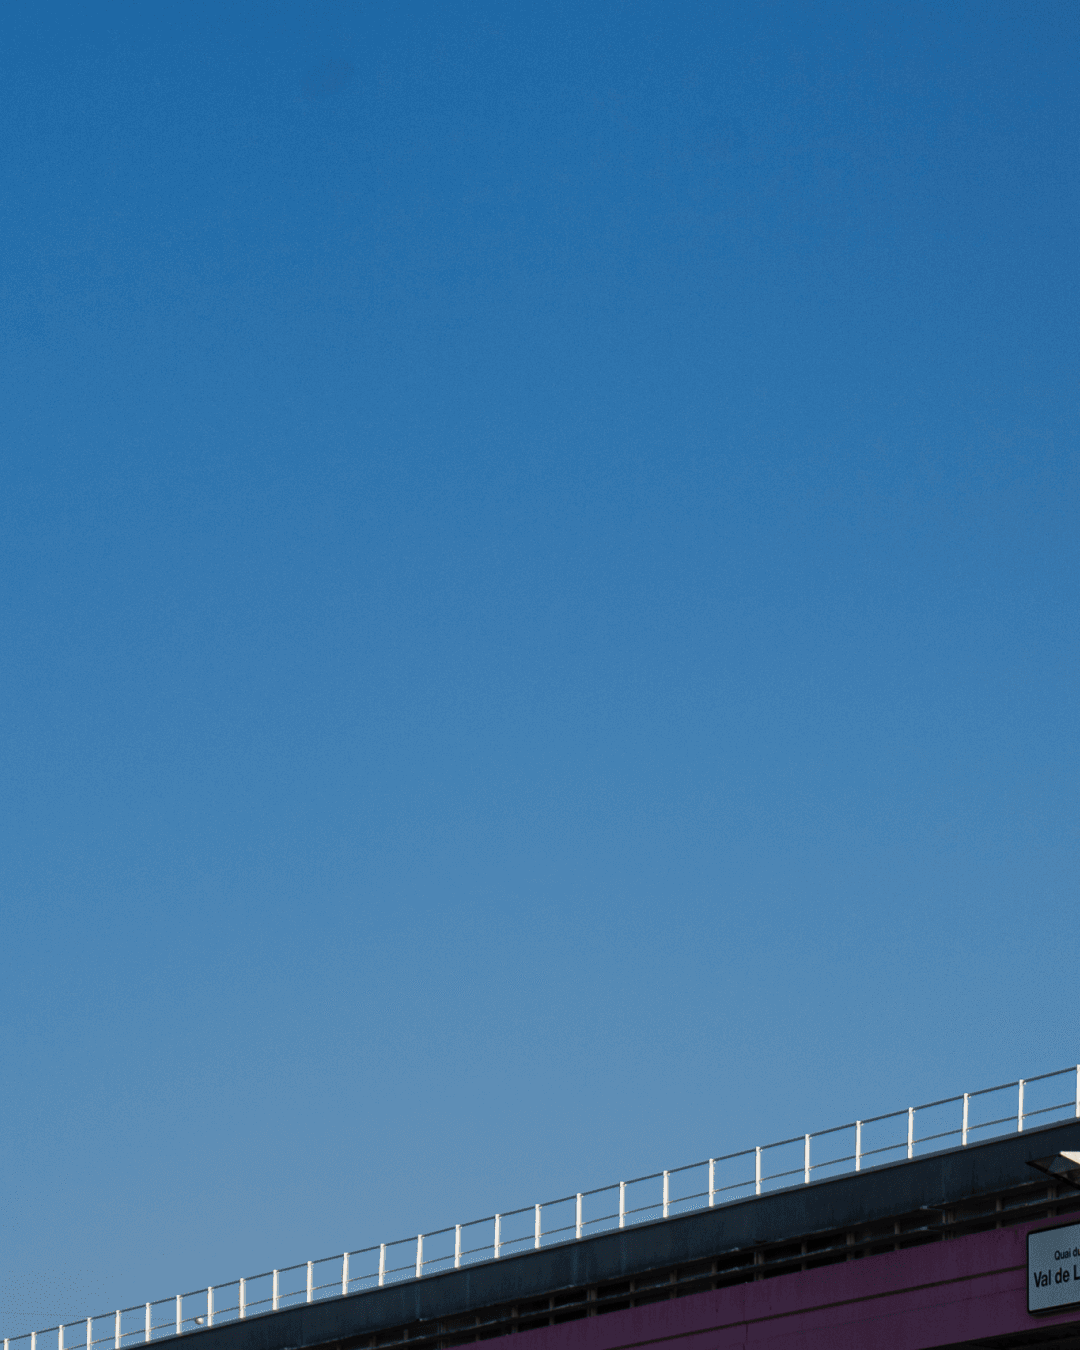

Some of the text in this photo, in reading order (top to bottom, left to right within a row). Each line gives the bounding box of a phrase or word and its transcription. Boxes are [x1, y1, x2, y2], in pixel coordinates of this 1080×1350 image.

[1054, 1250, 1071, 1261] Quai
[1034, 1270, 1052, 1288] Val
[1054, 1267, 1070, 1284] de
